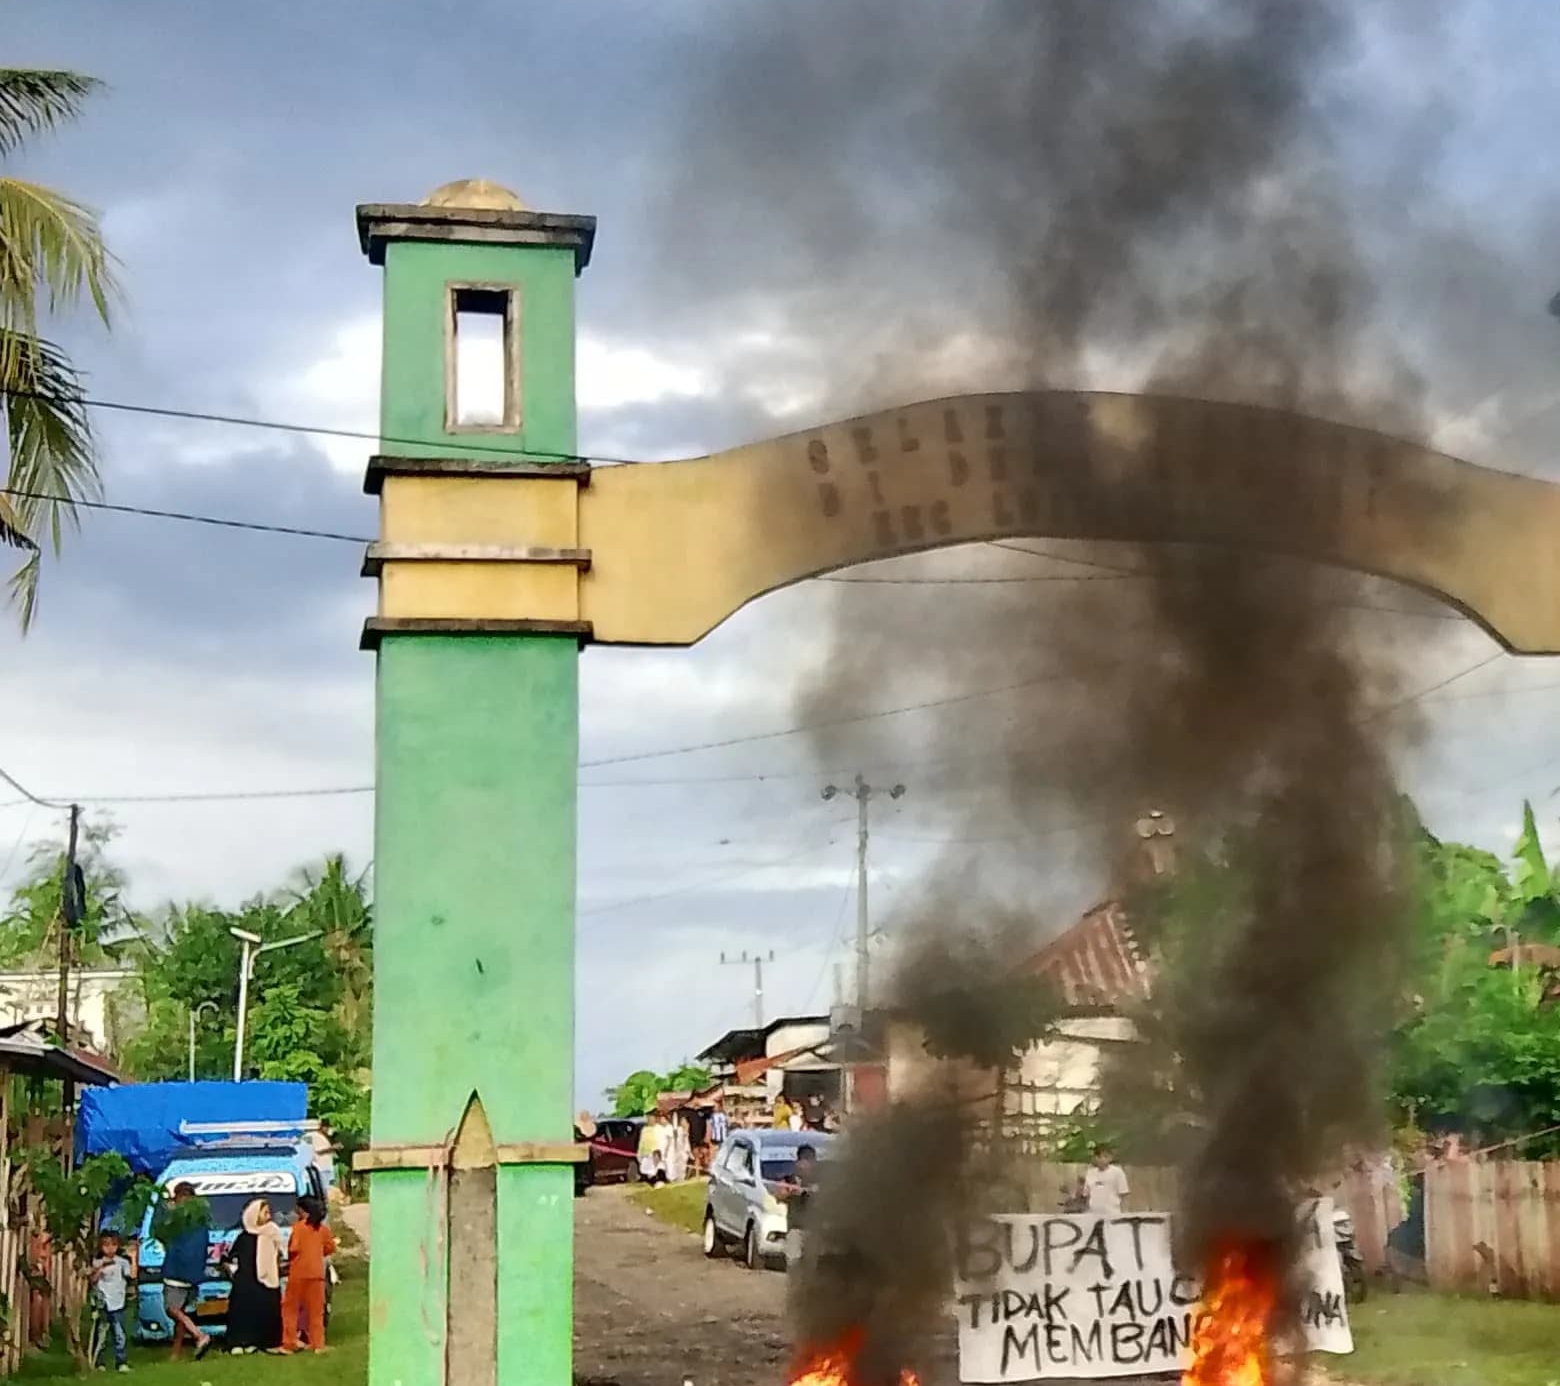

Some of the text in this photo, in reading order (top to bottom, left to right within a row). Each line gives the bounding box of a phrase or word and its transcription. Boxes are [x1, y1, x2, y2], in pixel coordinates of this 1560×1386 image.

[957, 1216, 1167, 1282] BUPAT
[959, 1283, 1070, 1329] TIDAK
[1087, 1278, 1163, 1322] TAU
[1000, 1312, 1194, 1376] MEMBAN
